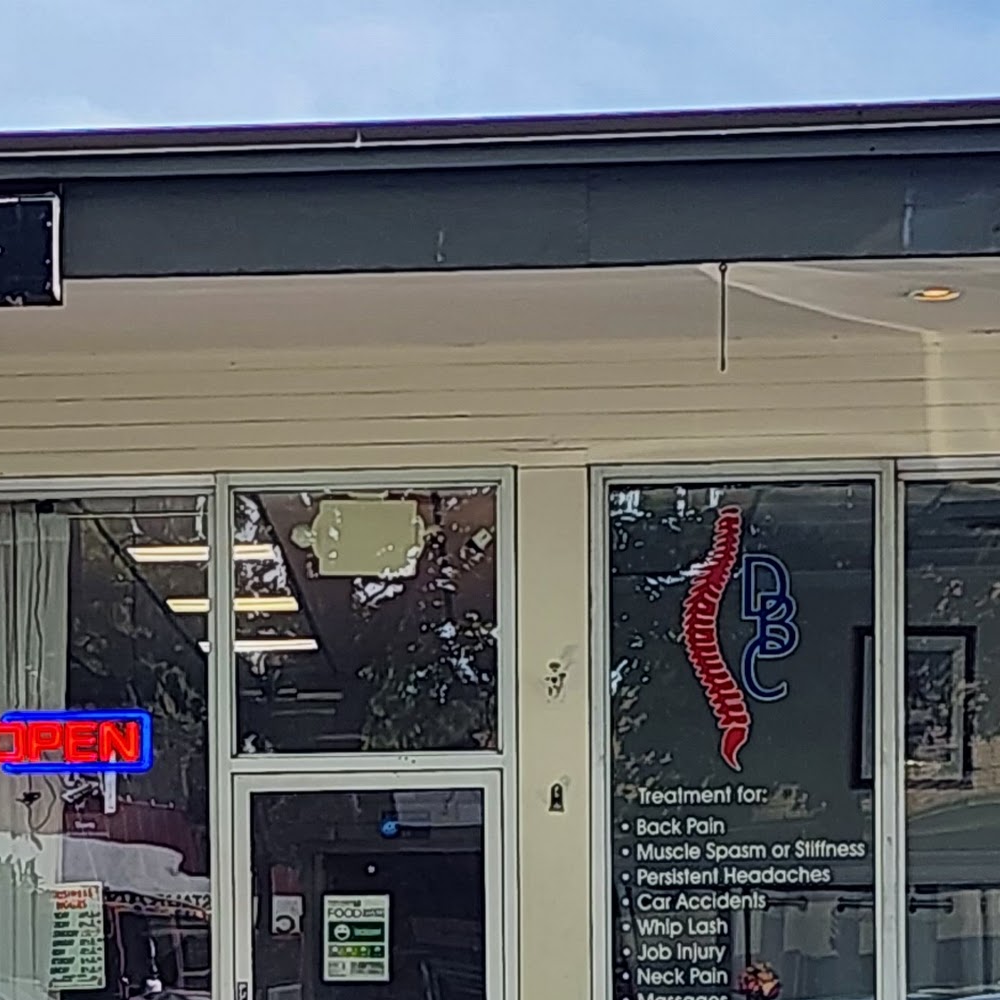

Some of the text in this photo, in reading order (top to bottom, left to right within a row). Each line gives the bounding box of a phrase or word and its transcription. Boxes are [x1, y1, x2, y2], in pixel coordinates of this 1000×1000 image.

[638, 786, 768, 804] Treatment for:
[637, 817, 725, 836] Back Pain
[637, 841, 866, 861] Muscle Spasm or Stiffness
[637, 867, 831, 886] Persistent Headaches
[637, 892, 766, 911] Car Accidents
[637, 918, 728, 938] Whip Lash
[637, 943, 726, 962] Job Injury
[637, 968, 728, 985] Neck Pain
